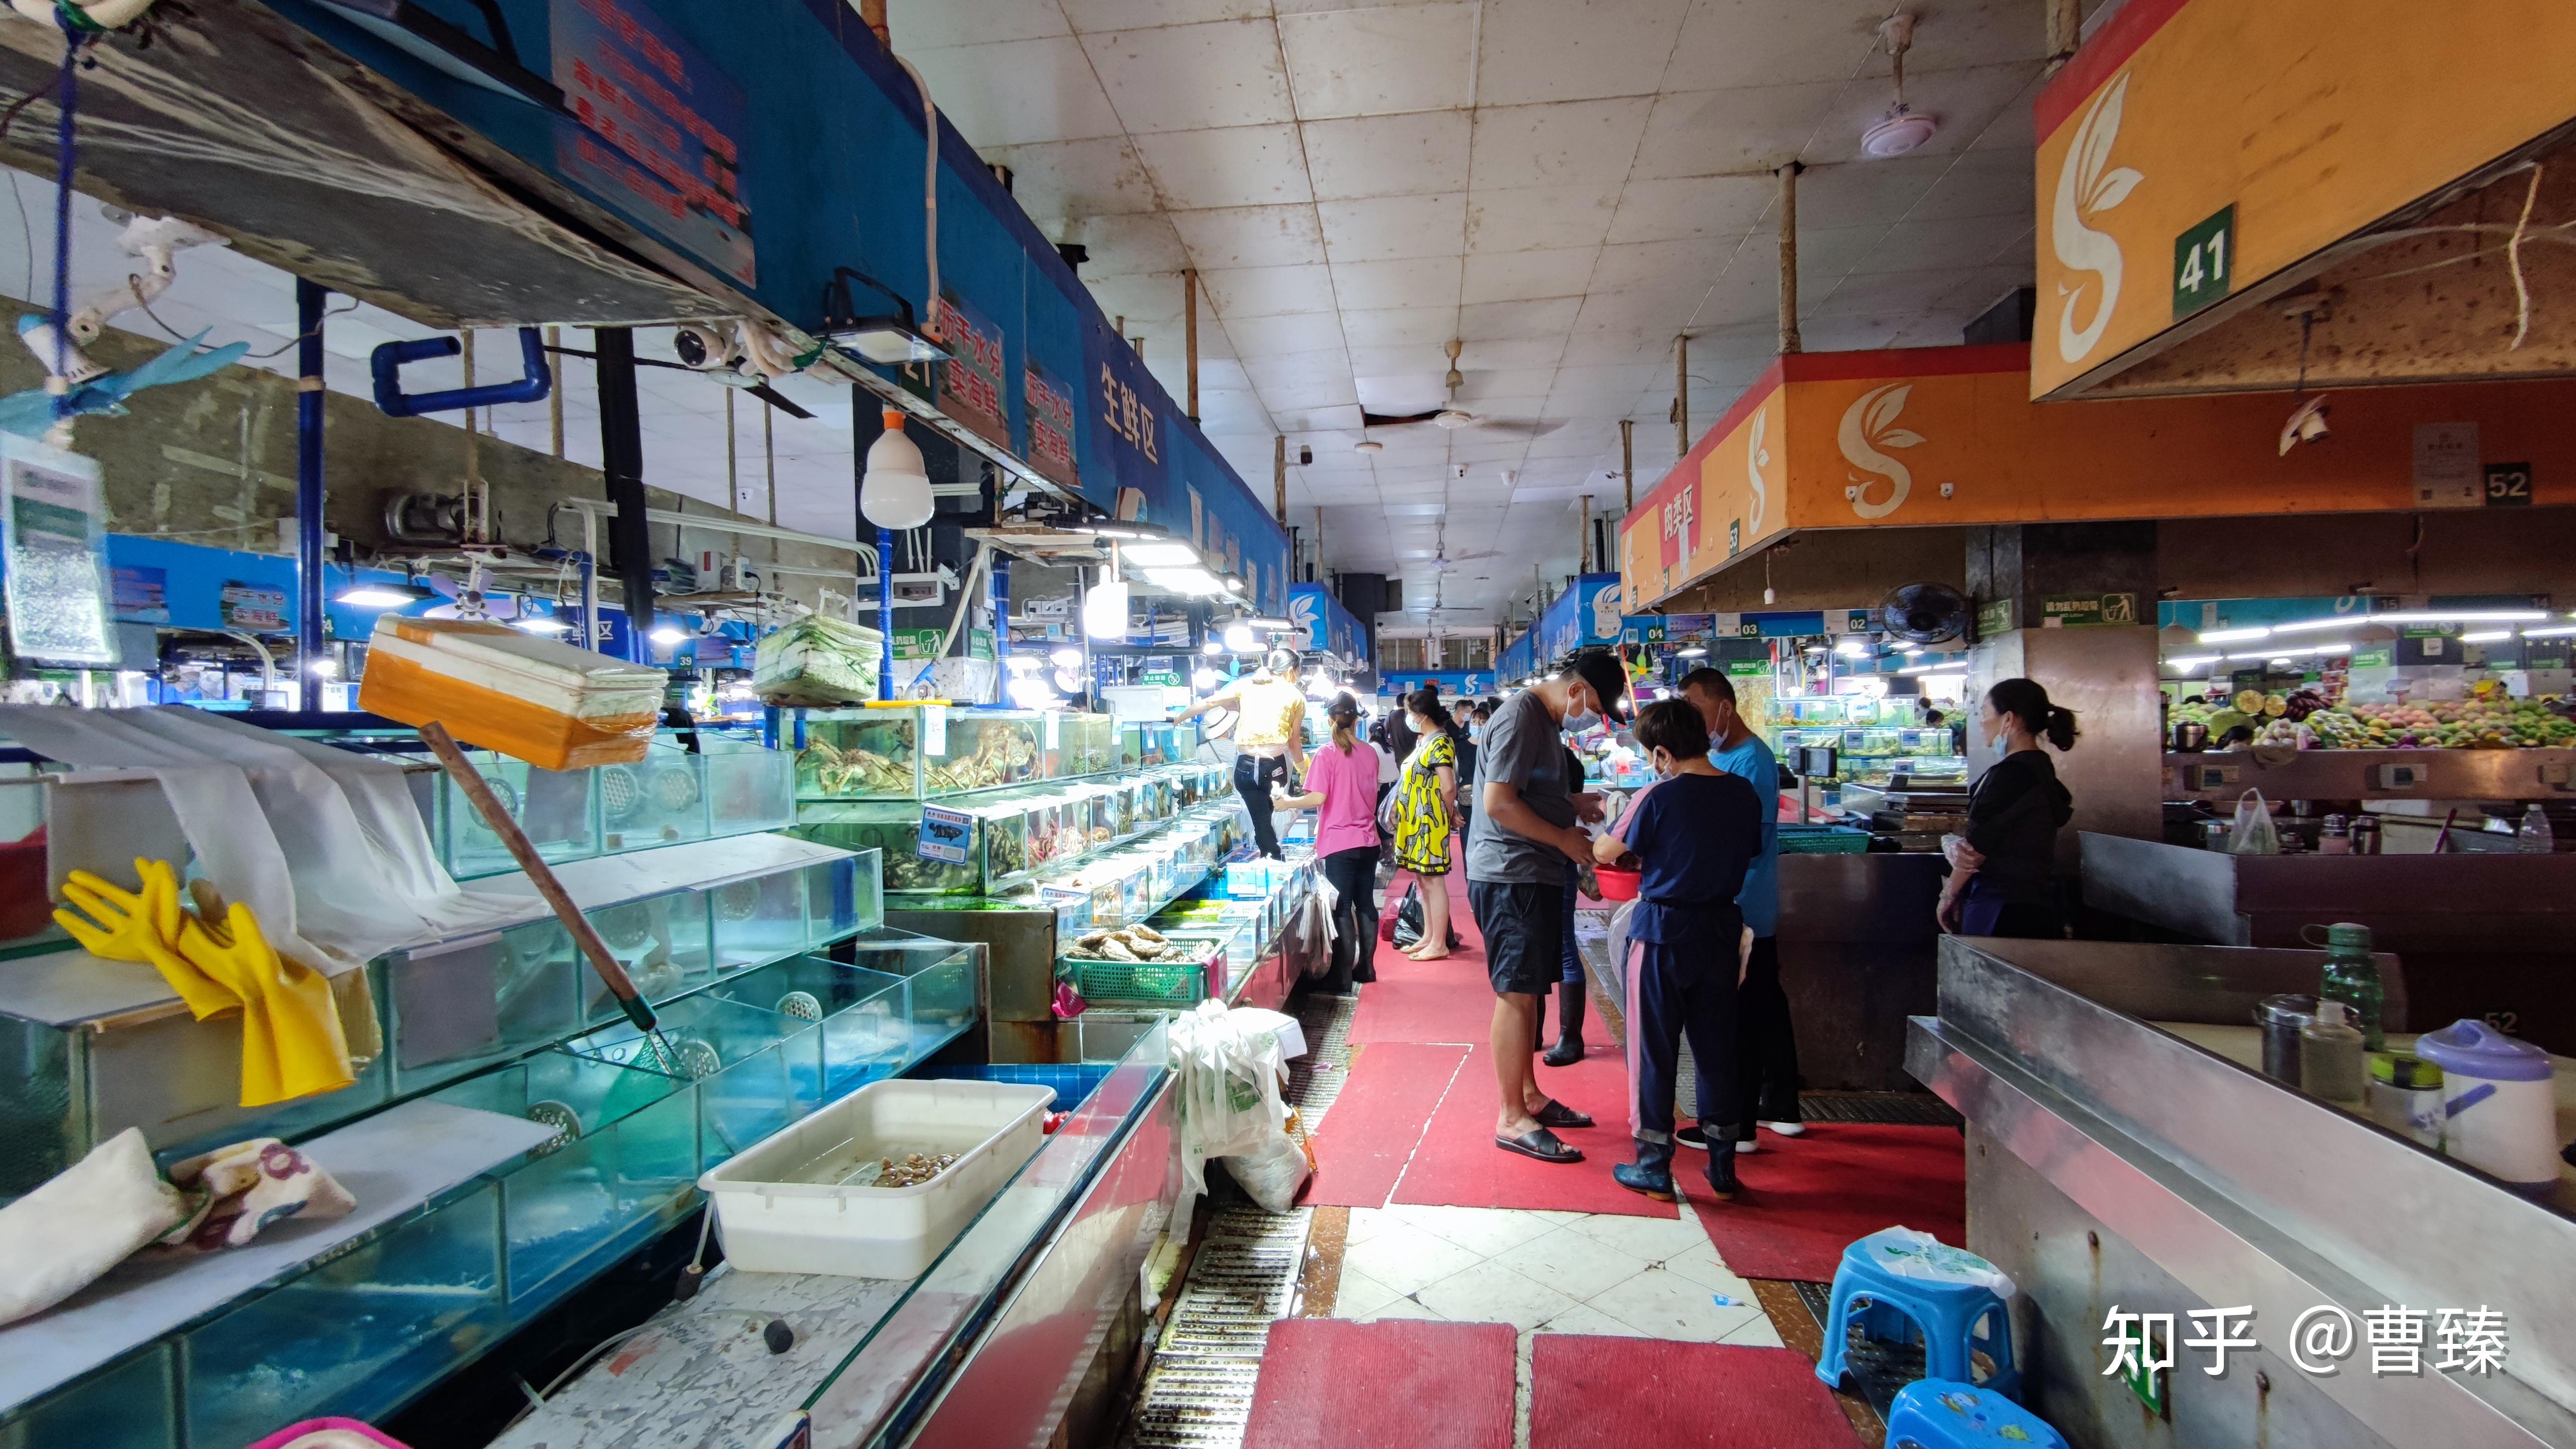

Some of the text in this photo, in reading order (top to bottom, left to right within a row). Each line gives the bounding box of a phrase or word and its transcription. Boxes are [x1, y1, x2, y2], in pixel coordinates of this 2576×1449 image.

[2179, 228, 2226, 293] 41
[938, 295, 1003, 379] 沥干水分
[950, 358, 998, 418] 卖海鲜
[1025, 369, 1072, 430] 沥干水分
[1101, 361, 1158, 465] 生鲜区
[1034, 418, 1070, 465] 卖海鲜
[2487, 472, 2528, 497] 52
[1664, 484, 1693, 542] 肉类区
[1729, 526, 1738, 549] 53
[233, 607, 278, 623] 卖海鲜
[1850, 619, 1866, 629] 02
[1648, 629, 1663, 639] 04
[1742, 624, 1758, 634] 03
[680, 656, 692, 666] 39
[2485, 1012, 2518, 1032] 52
